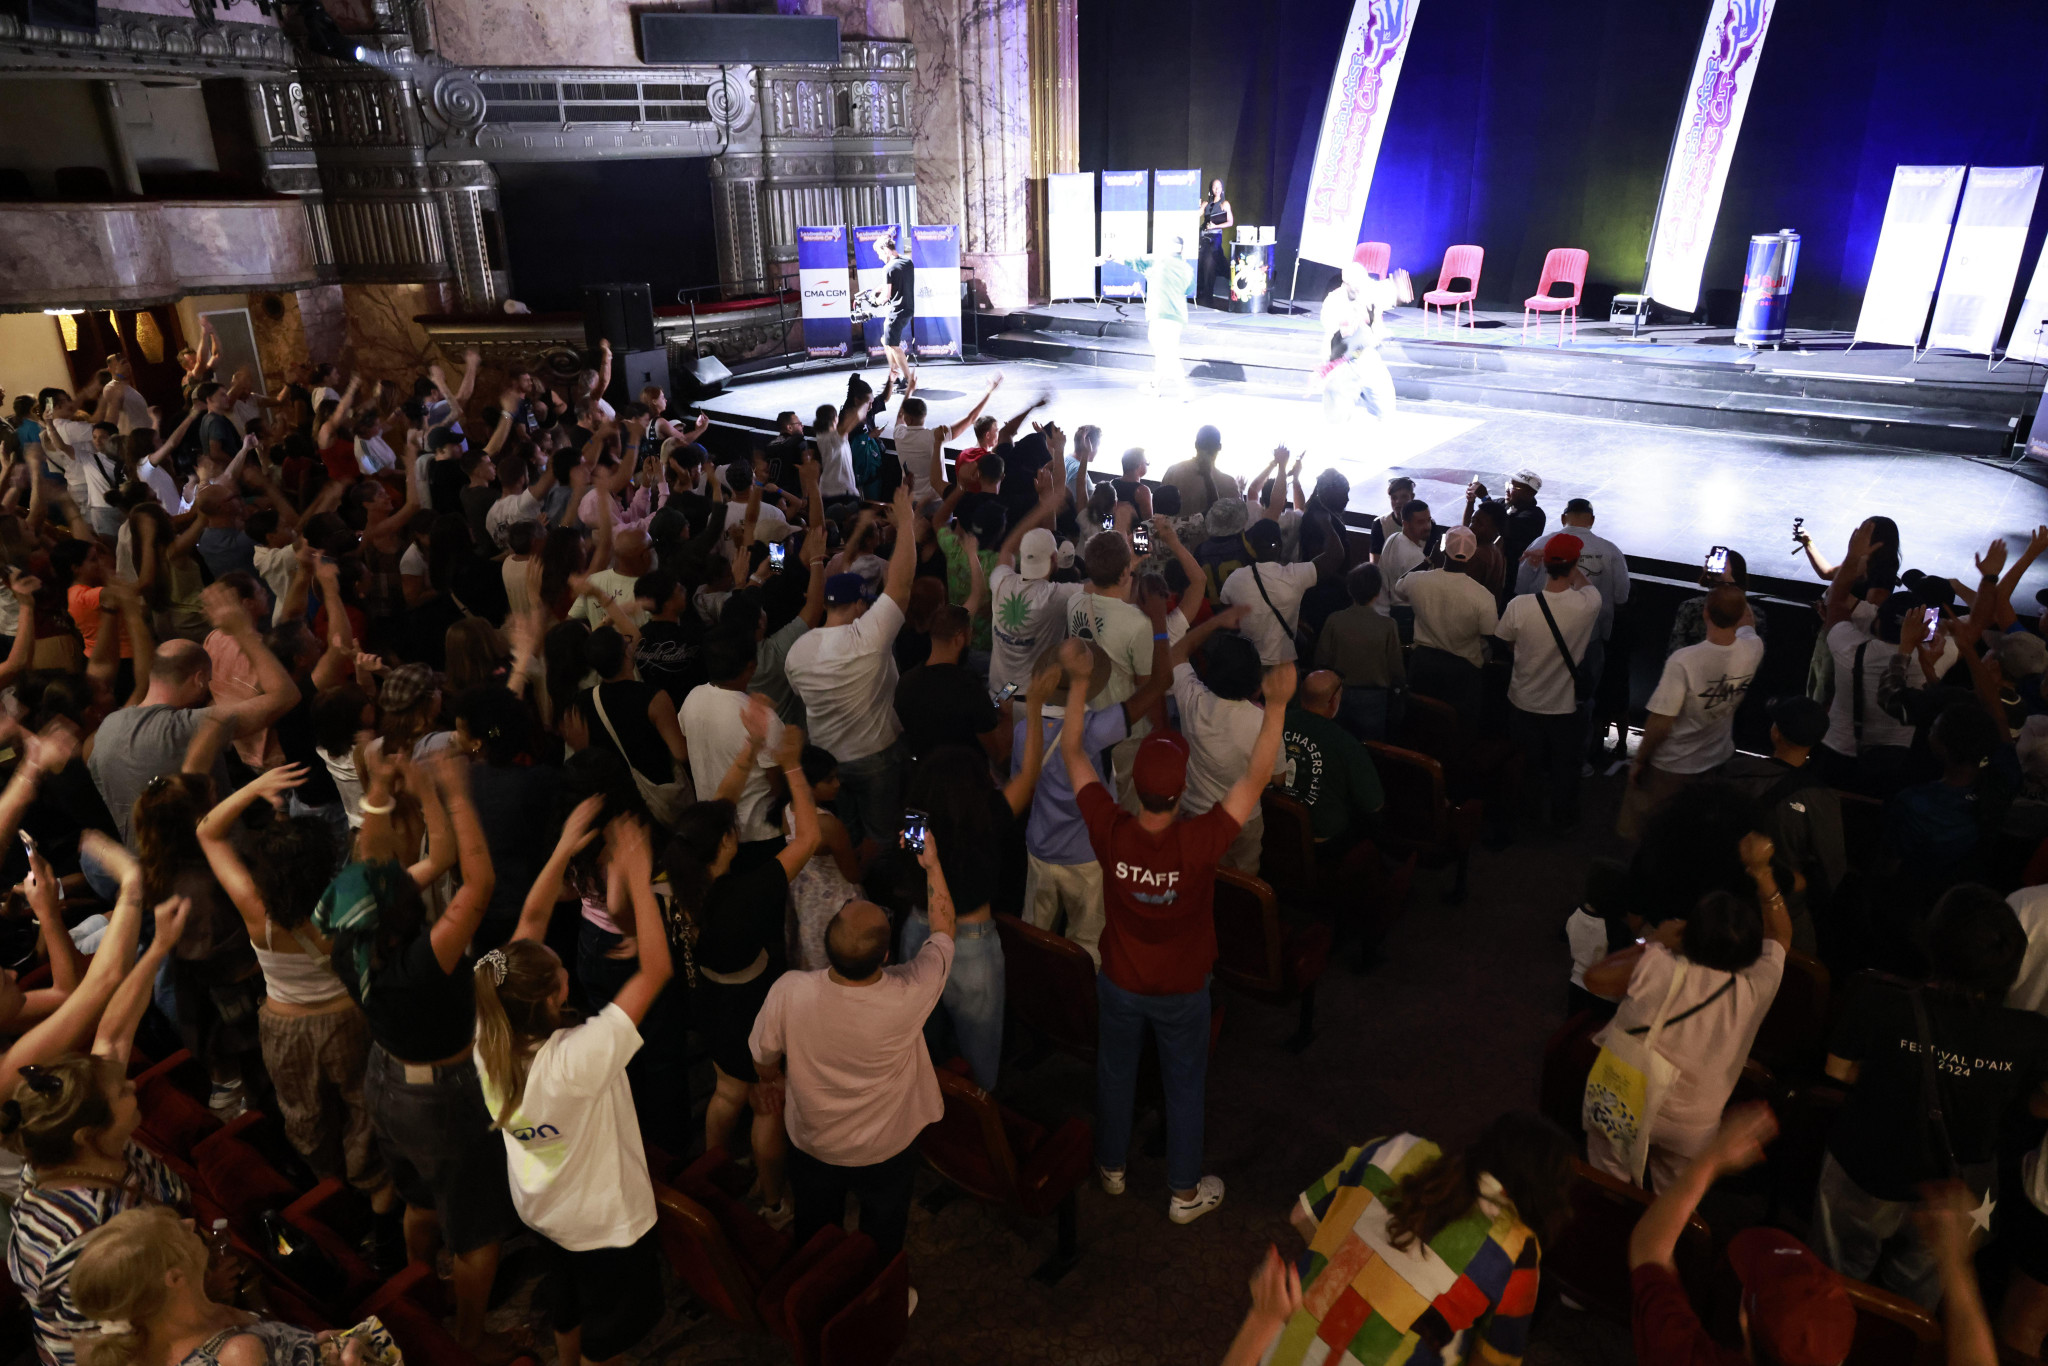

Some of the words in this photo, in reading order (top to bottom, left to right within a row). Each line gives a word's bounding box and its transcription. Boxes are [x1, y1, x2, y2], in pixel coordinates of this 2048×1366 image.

[1761, 274, 1787, 288] Bull
[804, 290, 825, 298] CMA
[826, 289, 847, 297] CGM
[1284, 731, 1323, 776] CHASERS
[1115, 861, 1180, 888] STAFF
[1974, 1058, 2014, 1072] D'AIX
